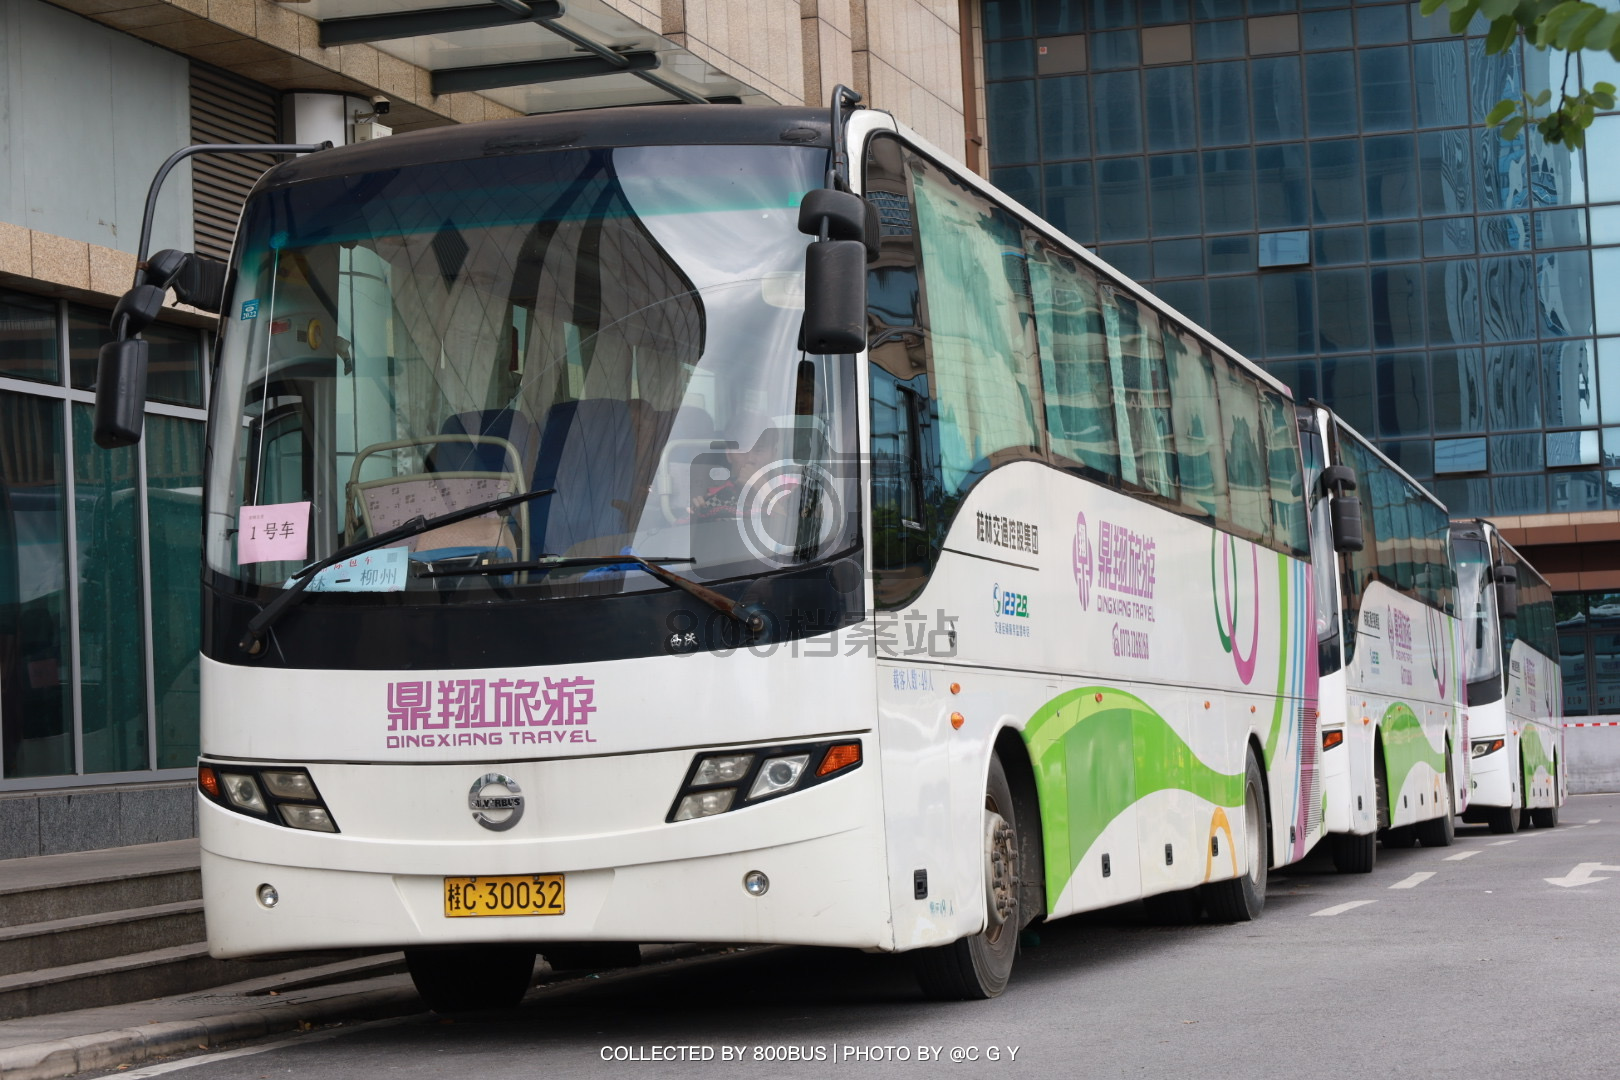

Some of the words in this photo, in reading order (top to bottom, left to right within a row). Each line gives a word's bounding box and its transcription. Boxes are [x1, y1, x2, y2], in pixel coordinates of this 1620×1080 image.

[250, 521, 295, 540] 1号车
[976, 510, 1039, 554] 桂林交通控股集团
[1097, 519, 1156, 599] 鼎翔旅游
[1002, 590, 1028, 617] 12328
[1097, 594, 1131, 617] DINGXIANG
[1132, 602, 1156, 623] TRAVEL
[386, 676, 597, 731] 鼎翔旅游
[386, 732, 503, 749] DINGXIANG
[510, 730, 597, 745] TRAVEL
